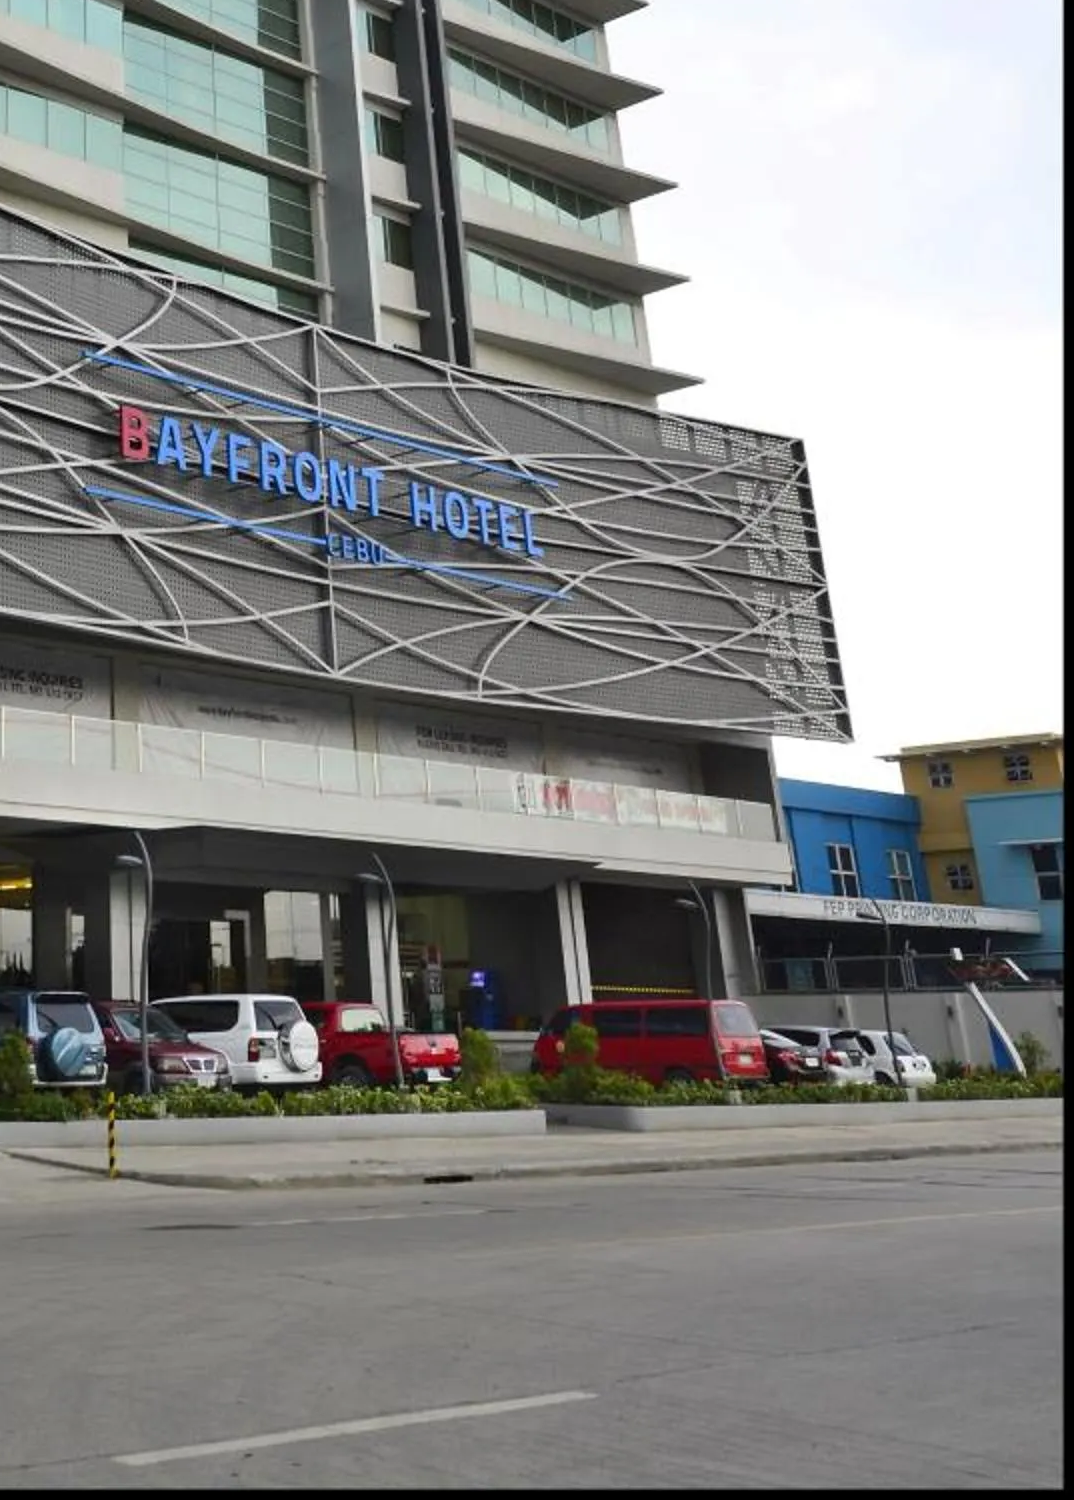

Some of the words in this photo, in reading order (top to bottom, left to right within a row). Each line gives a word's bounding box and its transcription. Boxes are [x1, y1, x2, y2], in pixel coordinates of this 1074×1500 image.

[118, 403, 385, 518] BAYFRONT
[409, 480, 544, 559] HOTEL
[327, 532, 387, 567] CEBU
[847, 901, 899, 919] PRINING
[901, 904, 978, 925] CORPORATION
